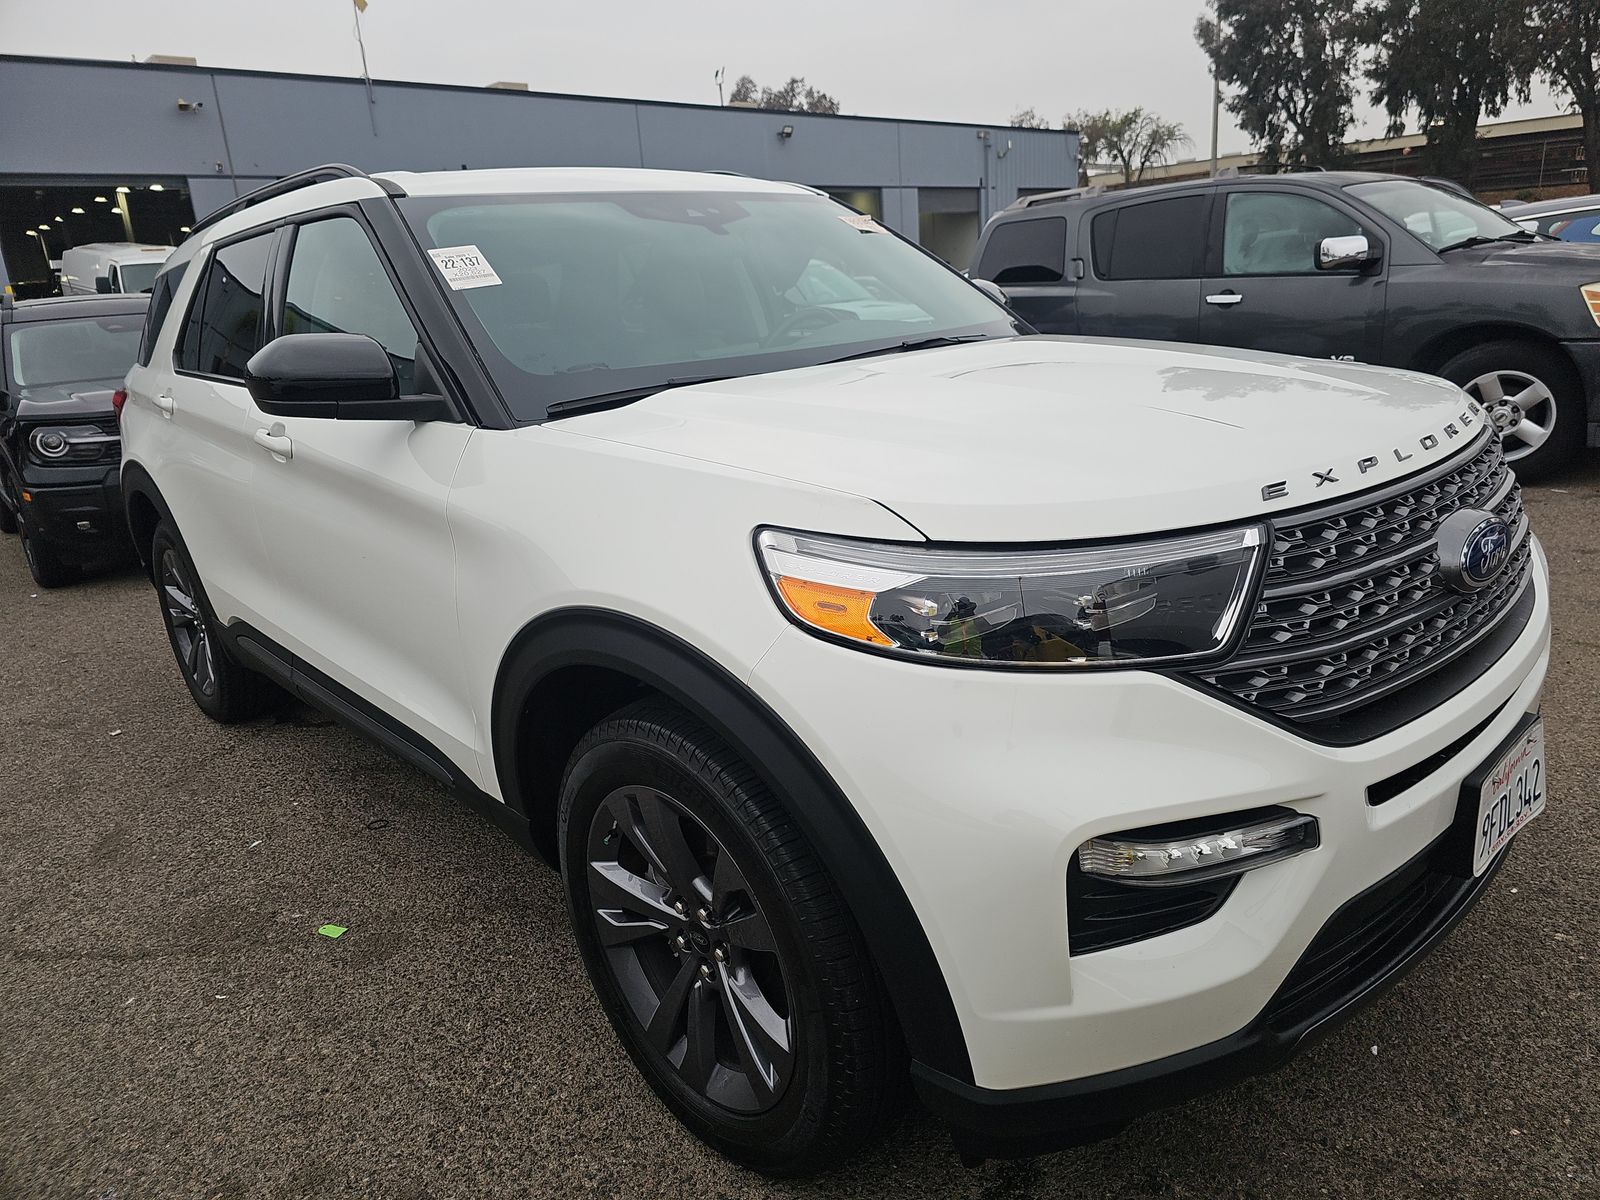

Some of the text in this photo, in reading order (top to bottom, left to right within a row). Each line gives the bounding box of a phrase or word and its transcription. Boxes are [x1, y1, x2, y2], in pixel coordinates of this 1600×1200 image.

[441, 256, 480, 269] 22:137
[1261, 402, 1480, 501] EXPLORER
[1480, 530, 1507, 574] Ford
[1480, 758, 1541, 859] 9FDL342
